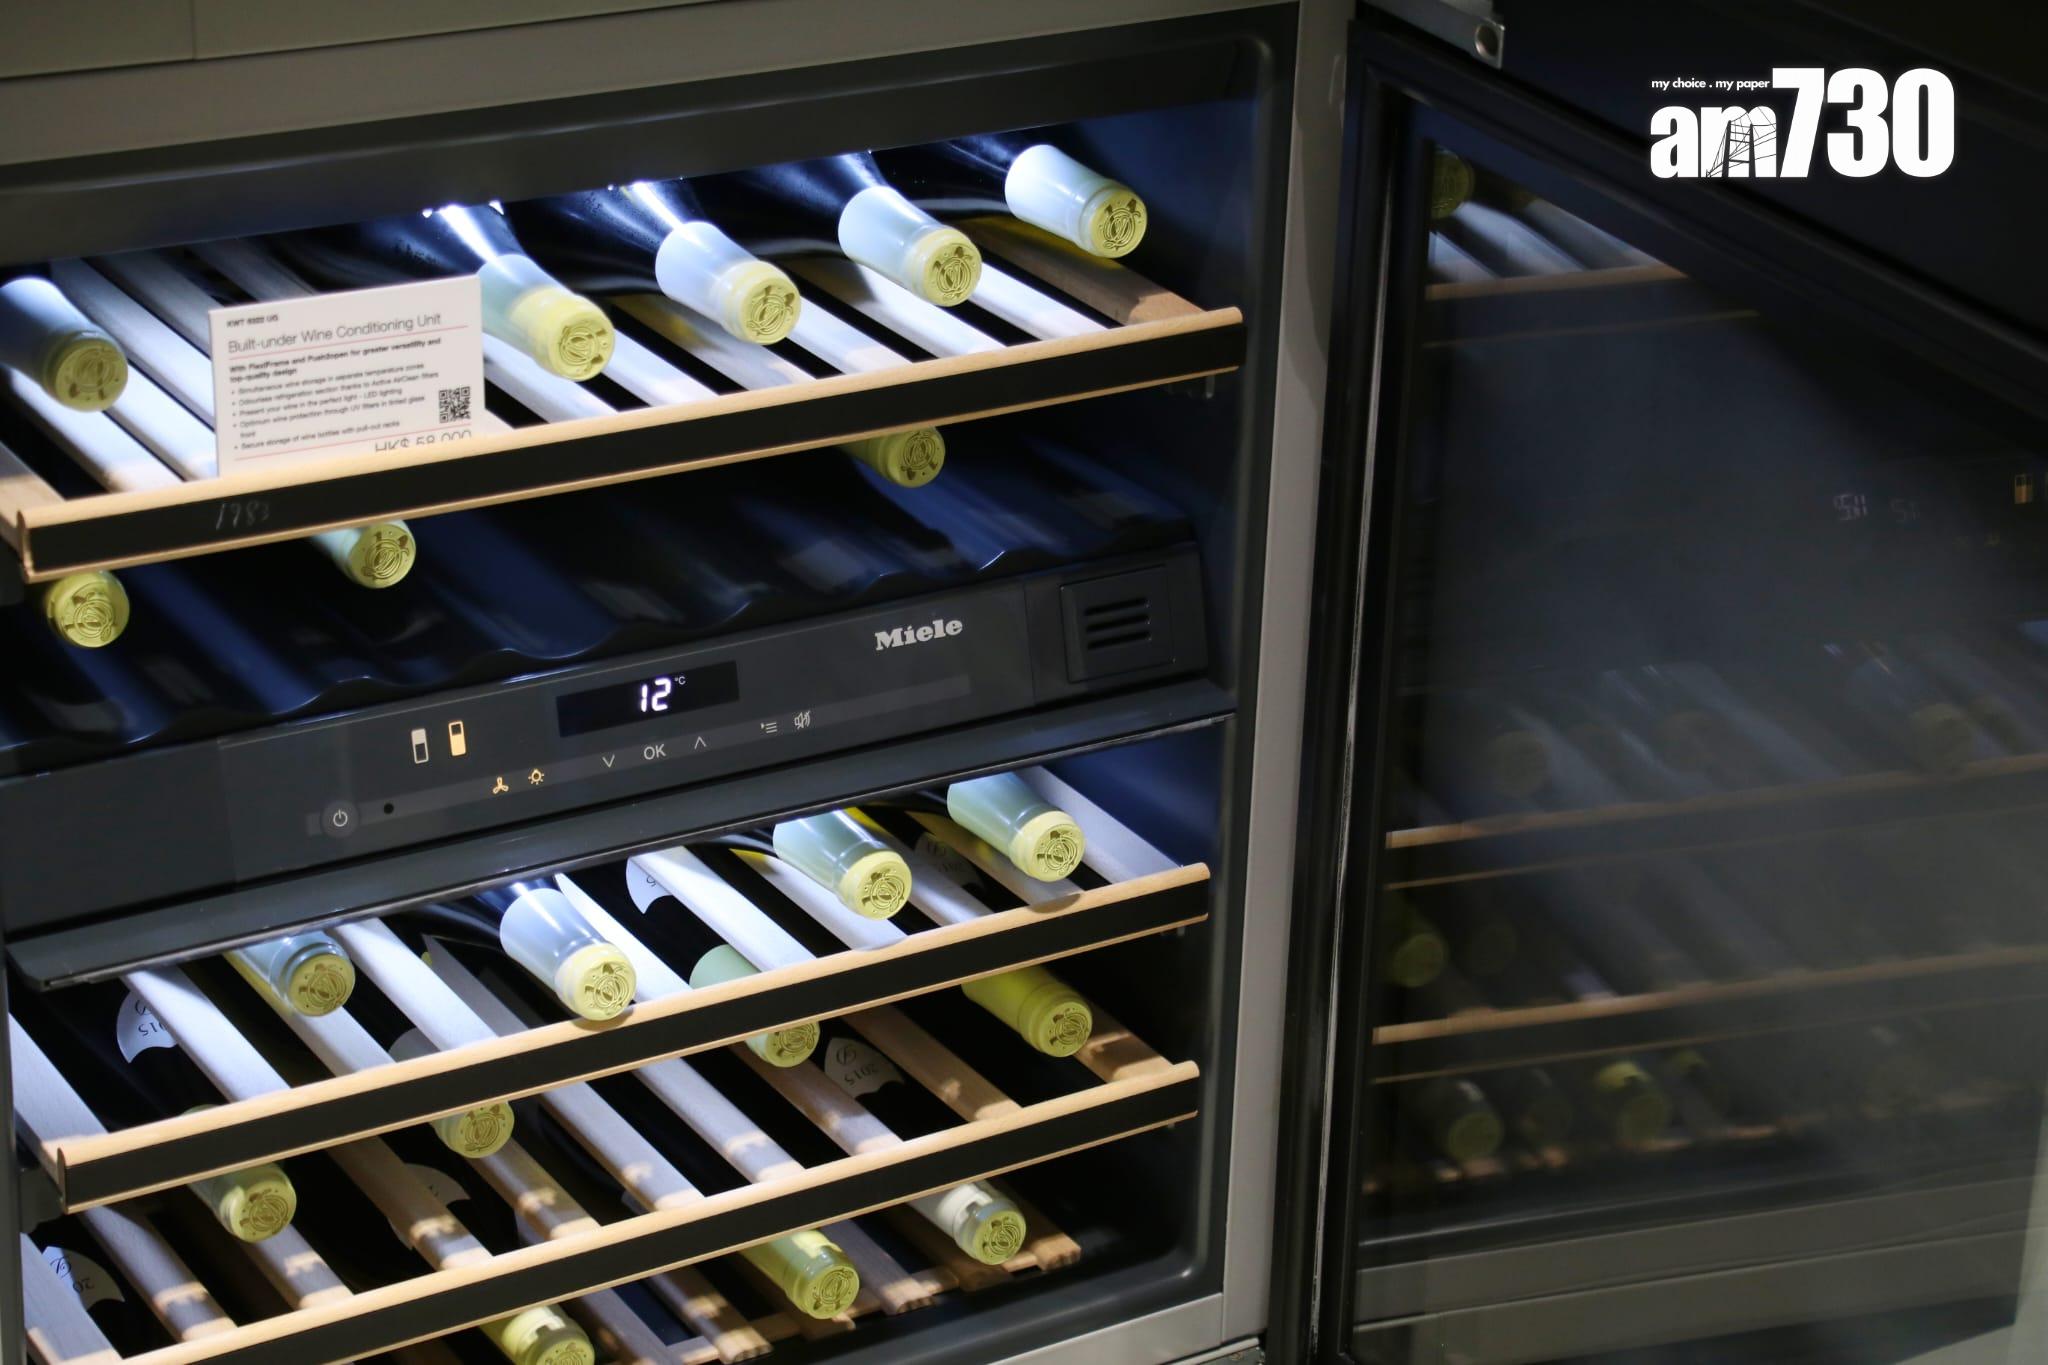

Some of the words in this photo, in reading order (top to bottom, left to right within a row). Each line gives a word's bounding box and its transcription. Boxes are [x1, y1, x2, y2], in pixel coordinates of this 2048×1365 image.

[228, 334, 297, 353] Built-under
[300, 329, 333, 342] Wine
[335, 319, 414, 338] Conditioning
[417, 313, 441, 327] Unit
[248, 360, 289, 369] FlexiFrame
[362, 346, 389, 355] greater
[391, 340, 425, 350] versatility
[230, 371, 270, 382] top-quality
[272, 368, 297, 376] design
[874, 619, 963, 651] Miele
[640, 677, 672, 713] 12
[643, 744, 667, 760] OK
